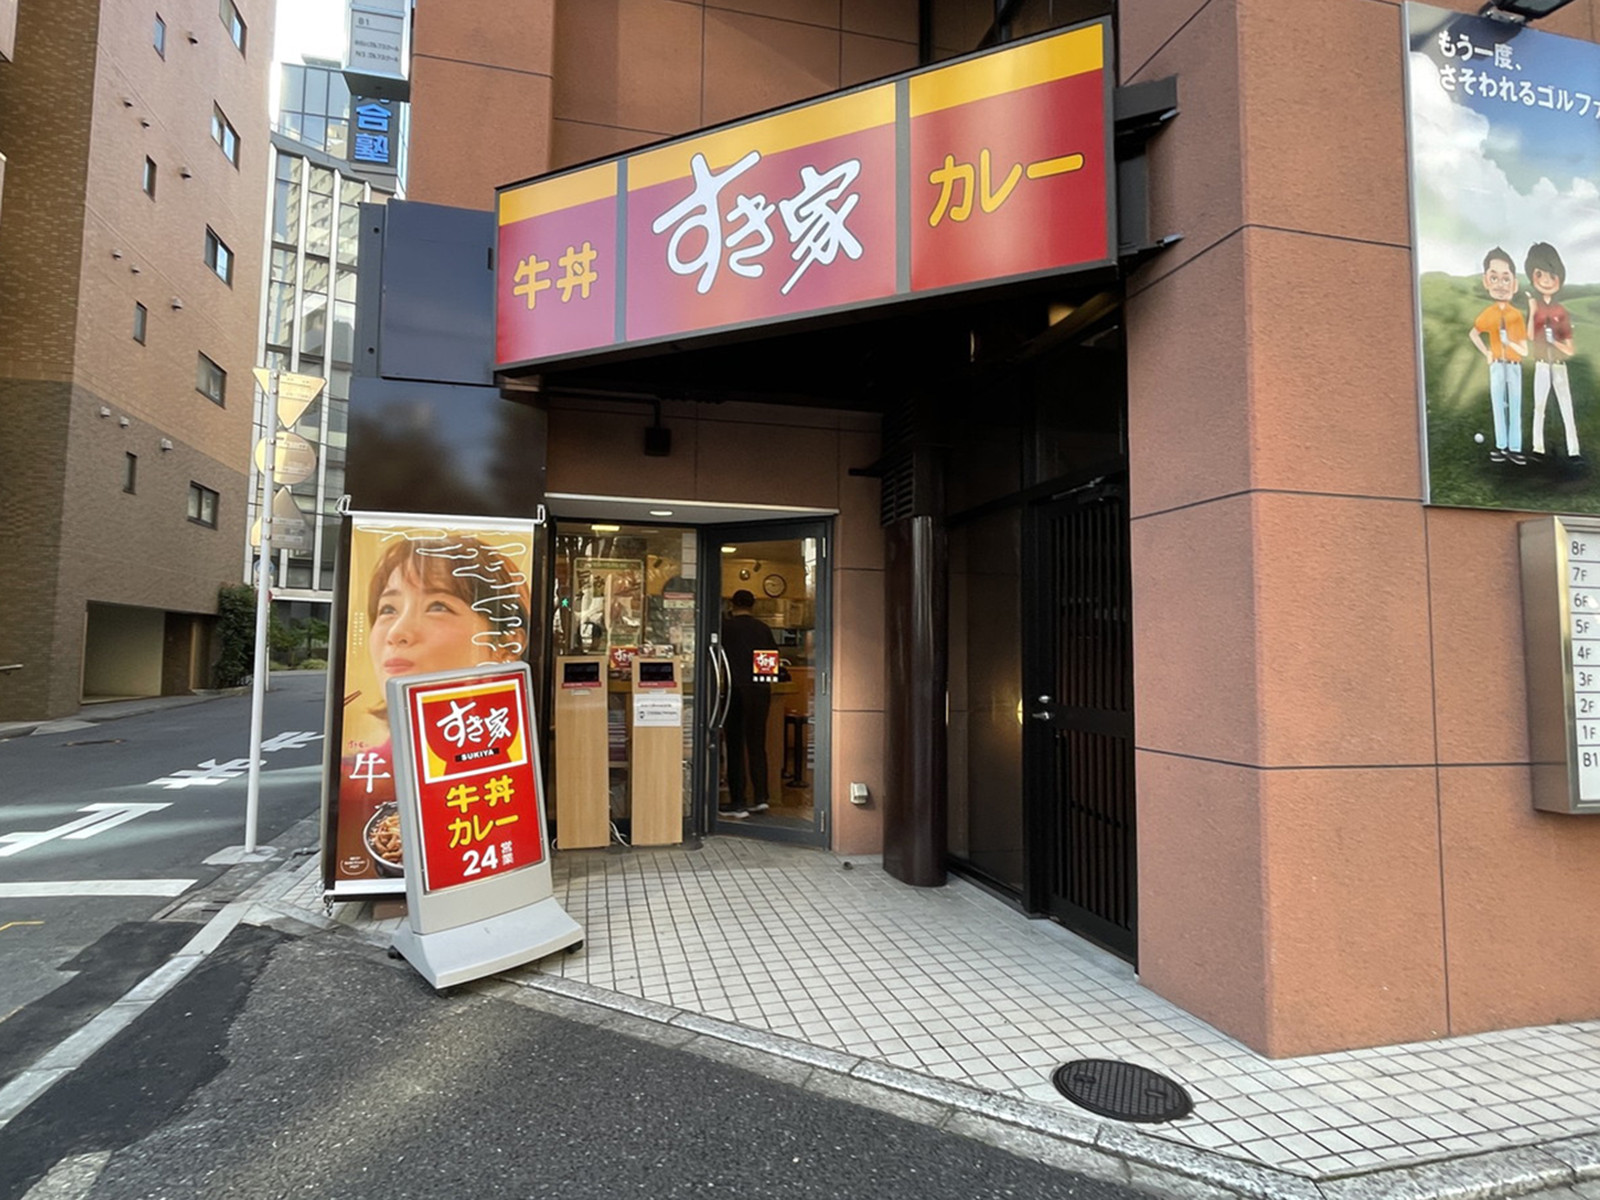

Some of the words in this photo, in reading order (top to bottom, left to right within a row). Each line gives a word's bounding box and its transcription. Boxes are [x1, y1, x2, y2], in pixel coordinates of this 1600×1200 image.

[1438, 30, 1522, 71] もう一度、
[354, 96, 393, 164] 合塾
[513, 241, 598, 311] 牛丼
[652, 150, 864, 296] すき家
[928, 148, 1085, 228] カレー
[1571, 540, 1587, 556] 8F
[1572, 566, 1588, 582] 7F
[1573, 592, 1589, 608] 6F
[1575, 618, 1590, 634] 5F
[1577, 645, 1592, 660] 4F
[1578, 671, 1593, 687] 3F
[1580, 697, 1595, 713] 2F
[436, 699, 512, 748] すき家
[1582, 724, 1596, 740] 1F
[461, 748, 495, 762] SUKIYA
[1583, 751, 1599, 768] B1
[446, 774, 516, 814] 牛丼
[447, 814, 520, 849] カレー
[461, 844, 499, 877] 24
